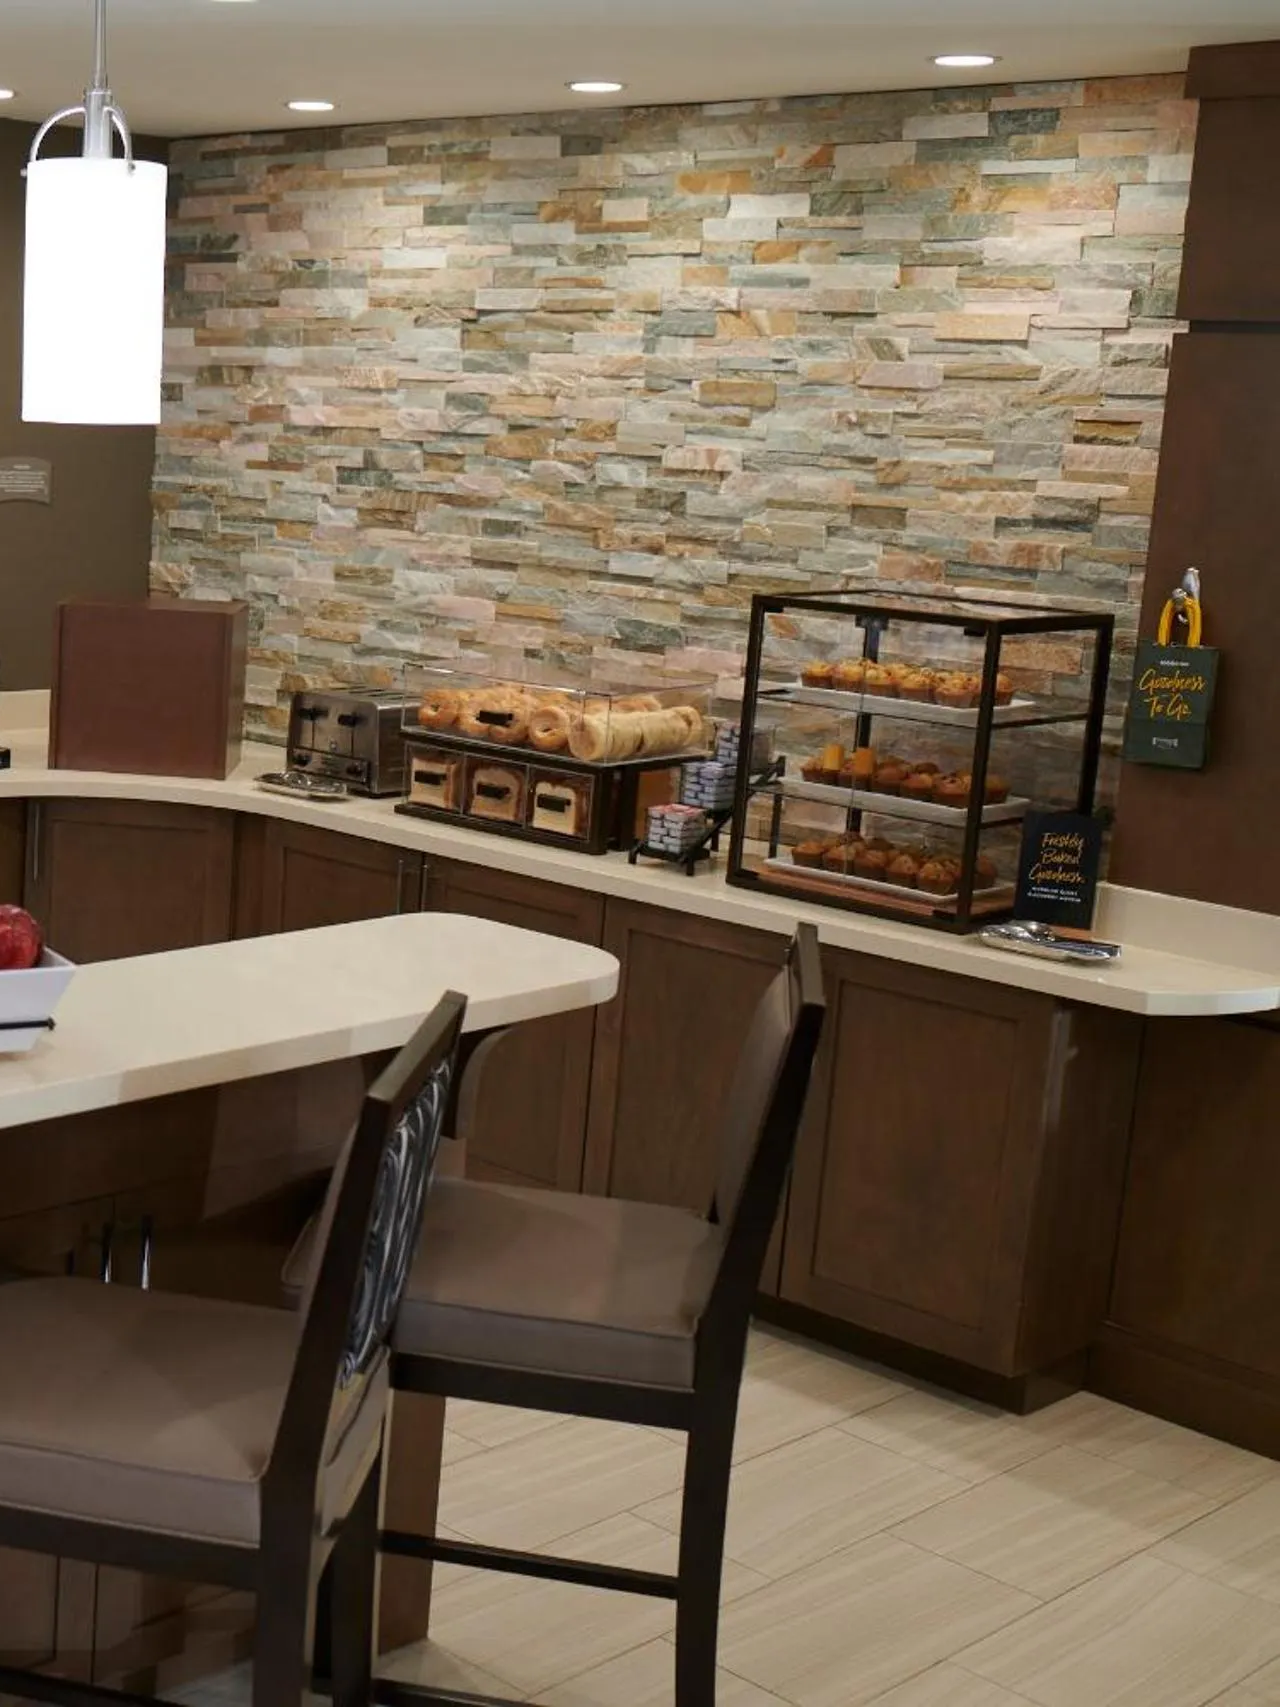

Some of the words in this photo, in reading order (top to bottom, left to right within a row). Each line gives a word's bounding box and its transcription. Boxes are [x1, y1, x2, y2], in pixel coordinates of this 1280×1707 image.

[1139, 668, 1205, 696] Goodness
[1144, 696, 1164, 718] To
[1166, 693, 1192, 721] Go
[1041, 832, 1085, 851] Freshly
[1040, 848, 1081, 865] Baked
